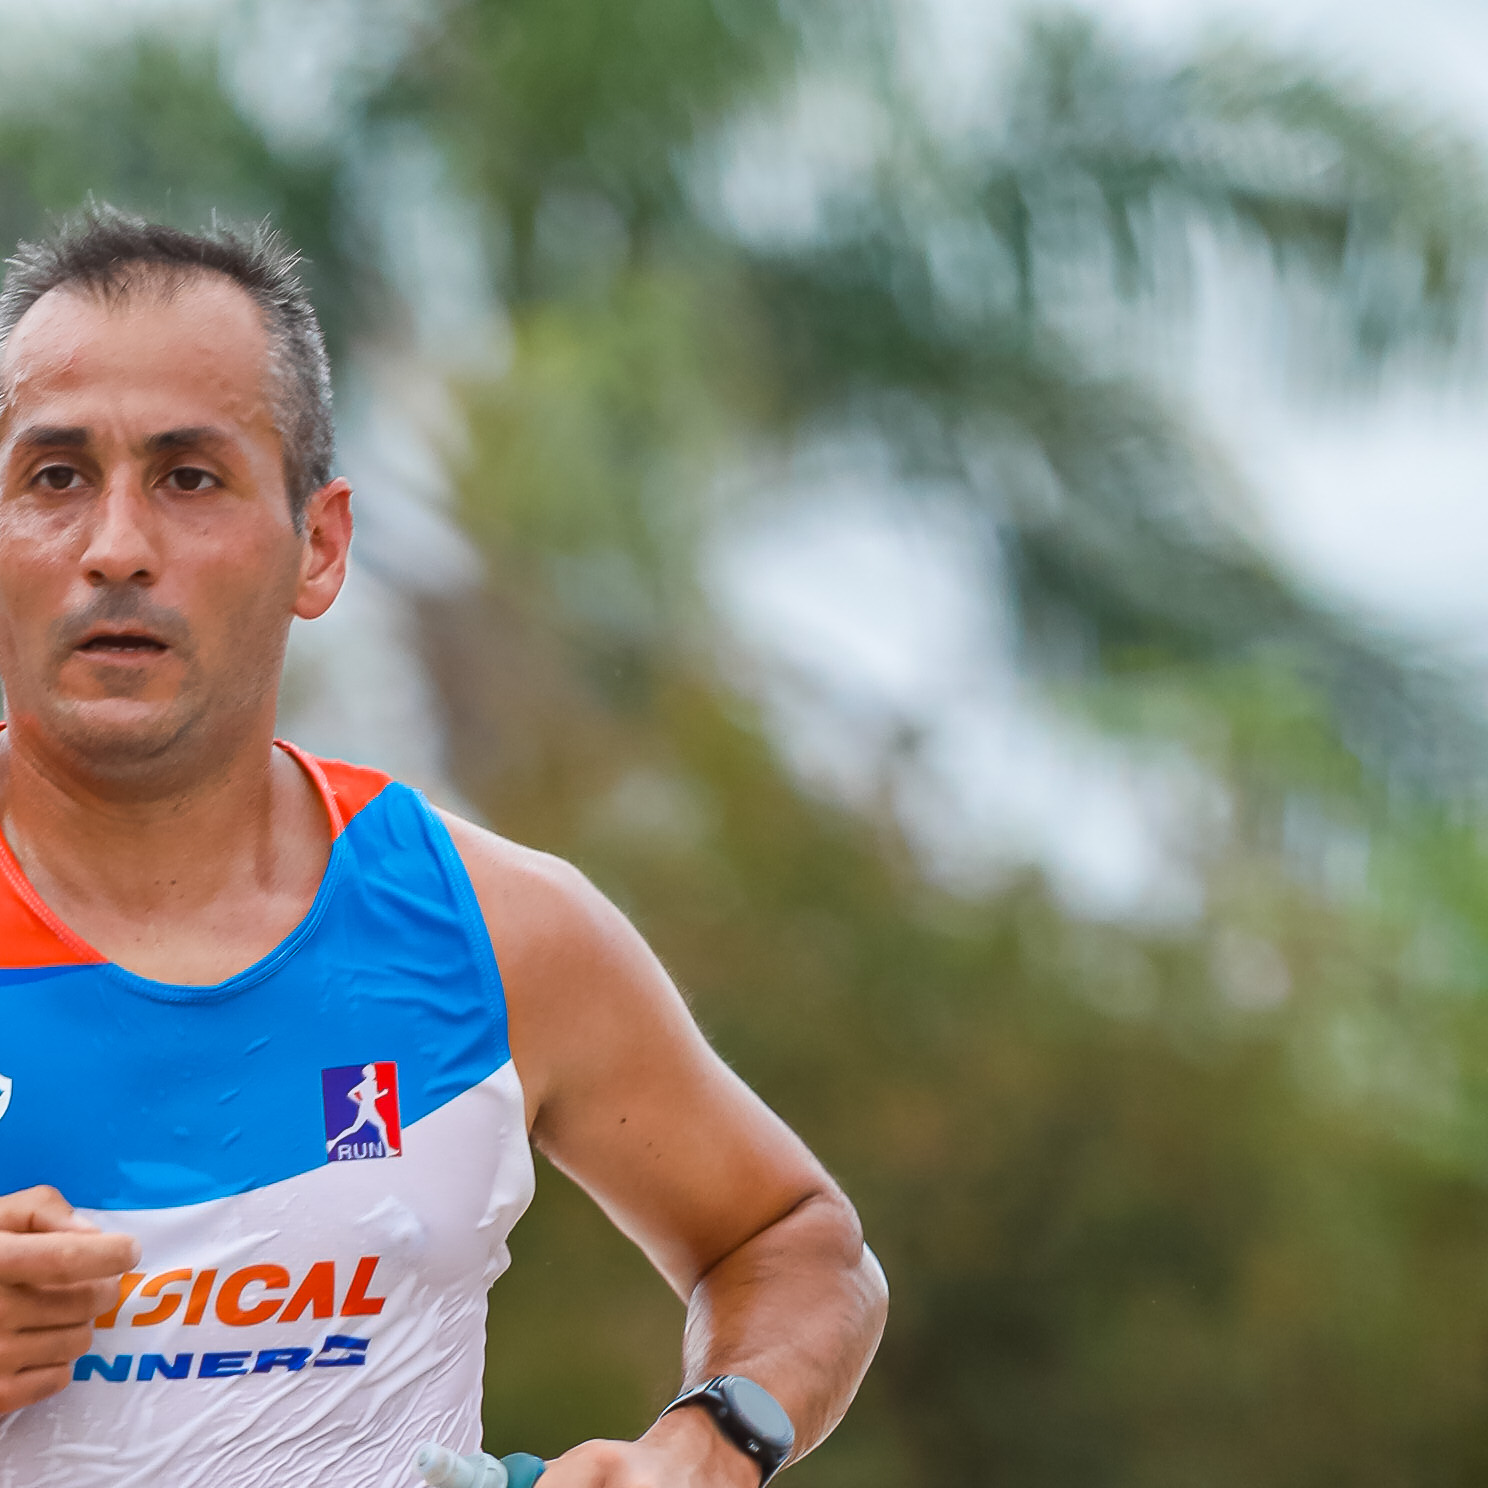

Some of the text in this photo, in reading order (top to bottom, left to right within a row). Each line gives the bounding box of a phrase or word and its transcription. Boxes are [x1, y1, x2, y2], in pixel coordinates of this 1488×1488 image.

[337, 1141, 383, 1161] RUN
[94, 1256, 386, 1329] YSICAL
[72, 1334, 372, 1382] NNERS
